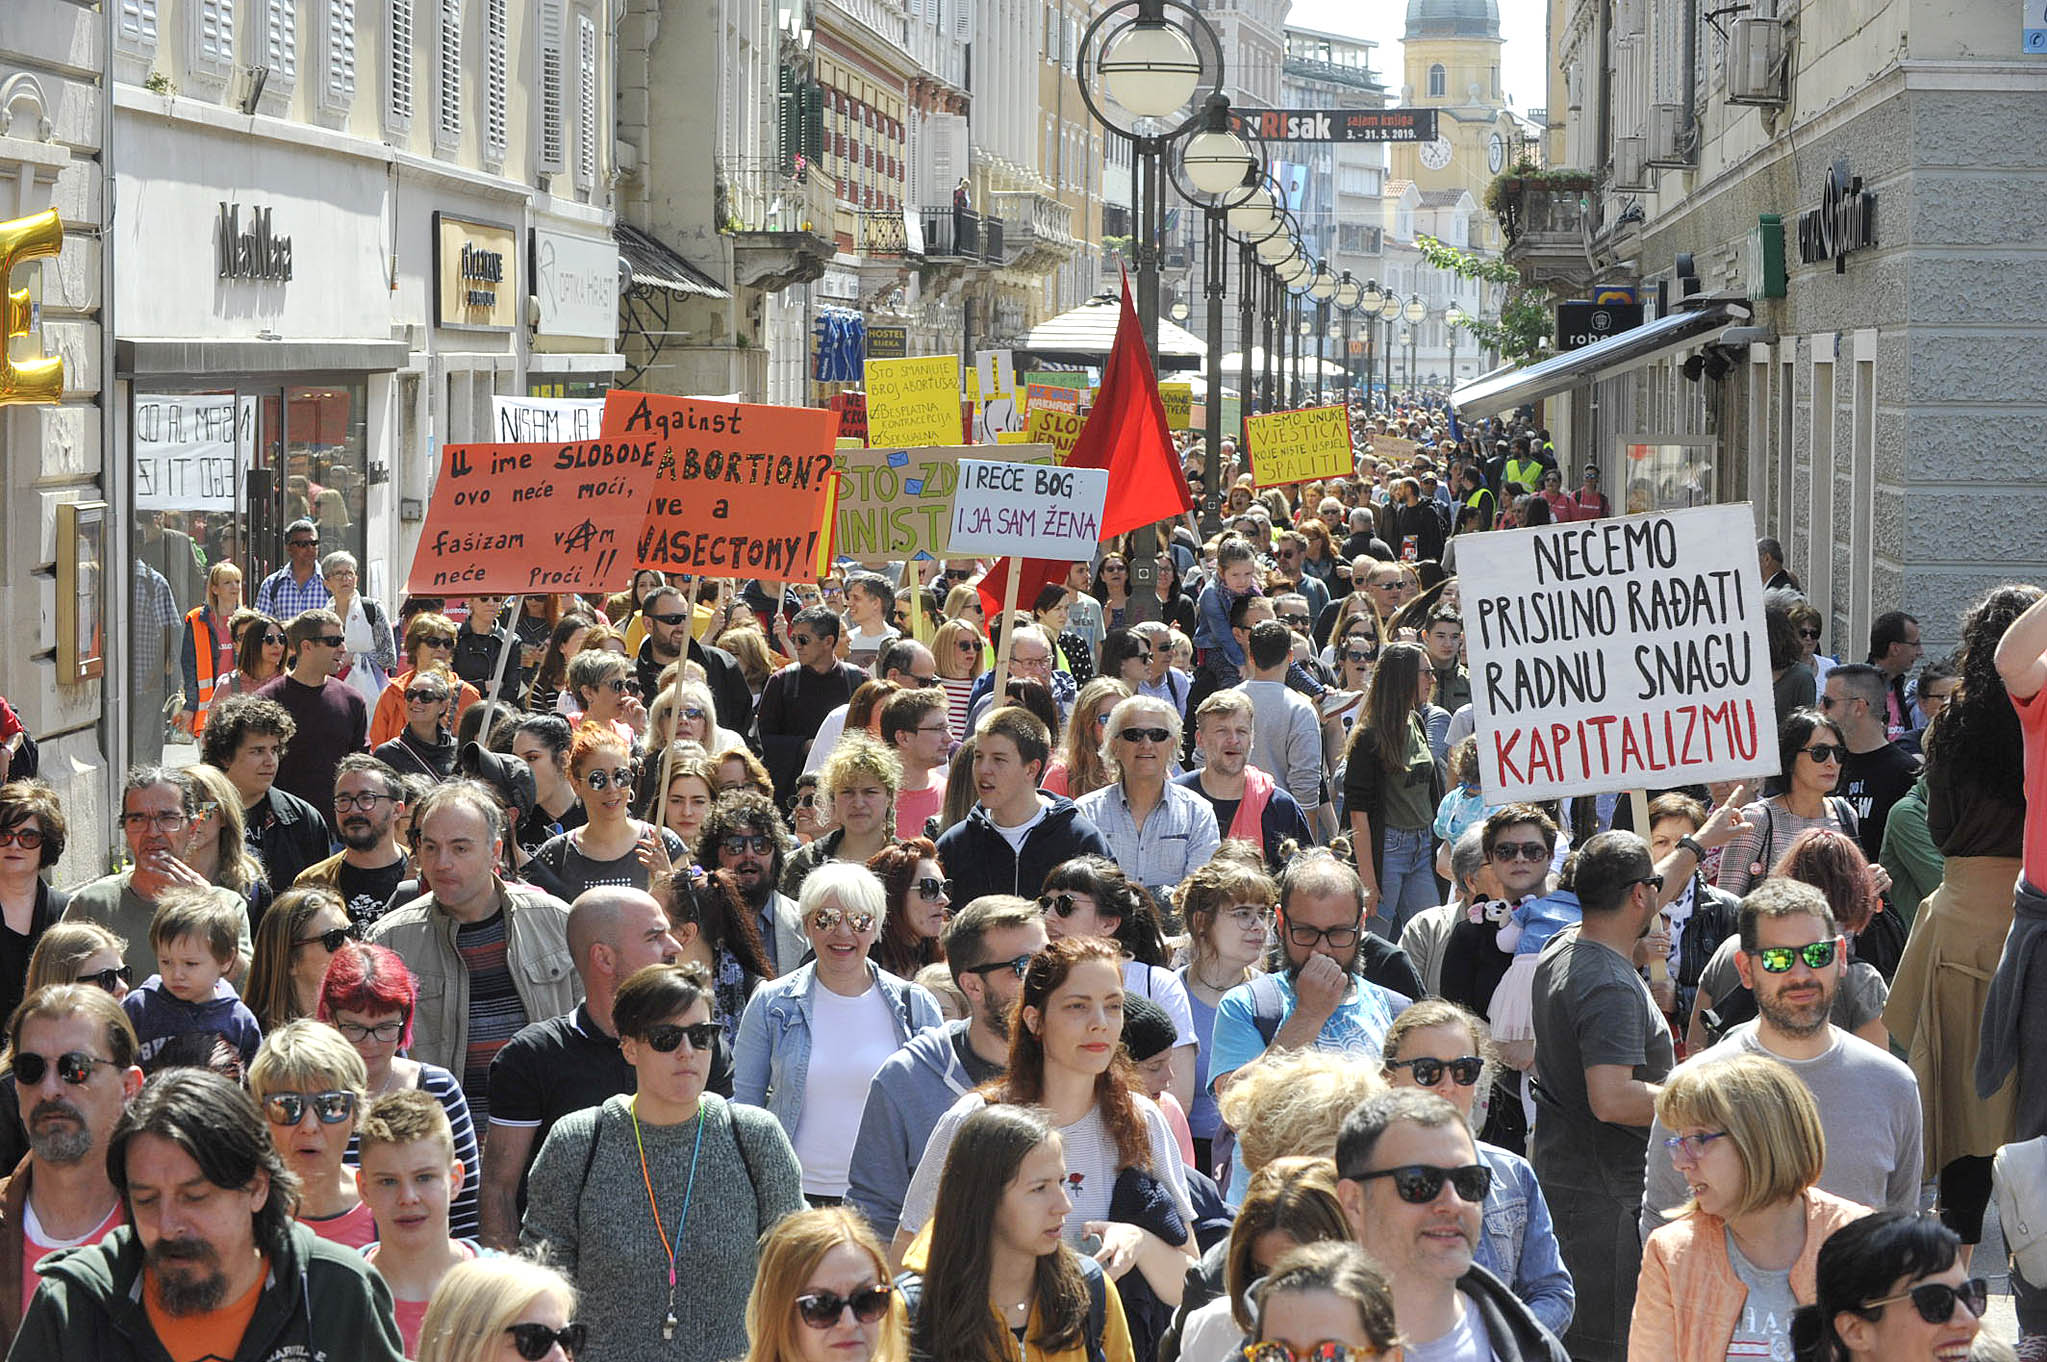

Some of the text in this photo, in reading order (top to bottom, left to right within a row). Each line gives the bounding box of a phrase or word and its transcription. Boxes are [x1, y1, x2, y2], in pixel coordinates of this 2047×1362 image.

[1347, 114, 1378, 127] sajam
[1381, 113, 1414, 127] knjiga
[1346, 129, 1355, 139] 3.
[1364, 129, 1379, 139] 31.
[1381, 129, 1390, 139] 5.
[1392, 129, 1416, 139] 2019.
[868, 329, 905, 338] HOSTEL
[871, 382, 901, 400] BROJ
[625, 397, 742, 440] Against
[881, 402, 939, 419] BESPLATNA
[1248, 408, 1347, 431] MI SMO UNUKE
[502, 406, 560, 443] NISAM
[569, 408, 589, 442] JA
[491, 451, 532, 475] ime
[554, 441, 657, 469] SLOBODE
[1254, 447, 1278, 461] KOJE
[1280, 444, 1307, 456] NISTE
[656, 445, 832, 492] ABORTION?
[965, 465, 971, 490] I
[1263, 454, 1338, 480] SPALITI
[454, 488, 491, 506] ovo
[512, 480, 554, 502] neće
[712, 499, 729, 518] a
[958, 504, 1097, 542] I JA SAM ŽENA
[1533, 518, 1677, 584] NEĆEMO
[433, 564, 486, 586] neće
[1478, 569, 1745, 649] PRISILNO RAĐATI
[1486, 630, 1751, 716] RADNU SNAGU
[1494, 698, 1758, 787] KAPITALIZMU
